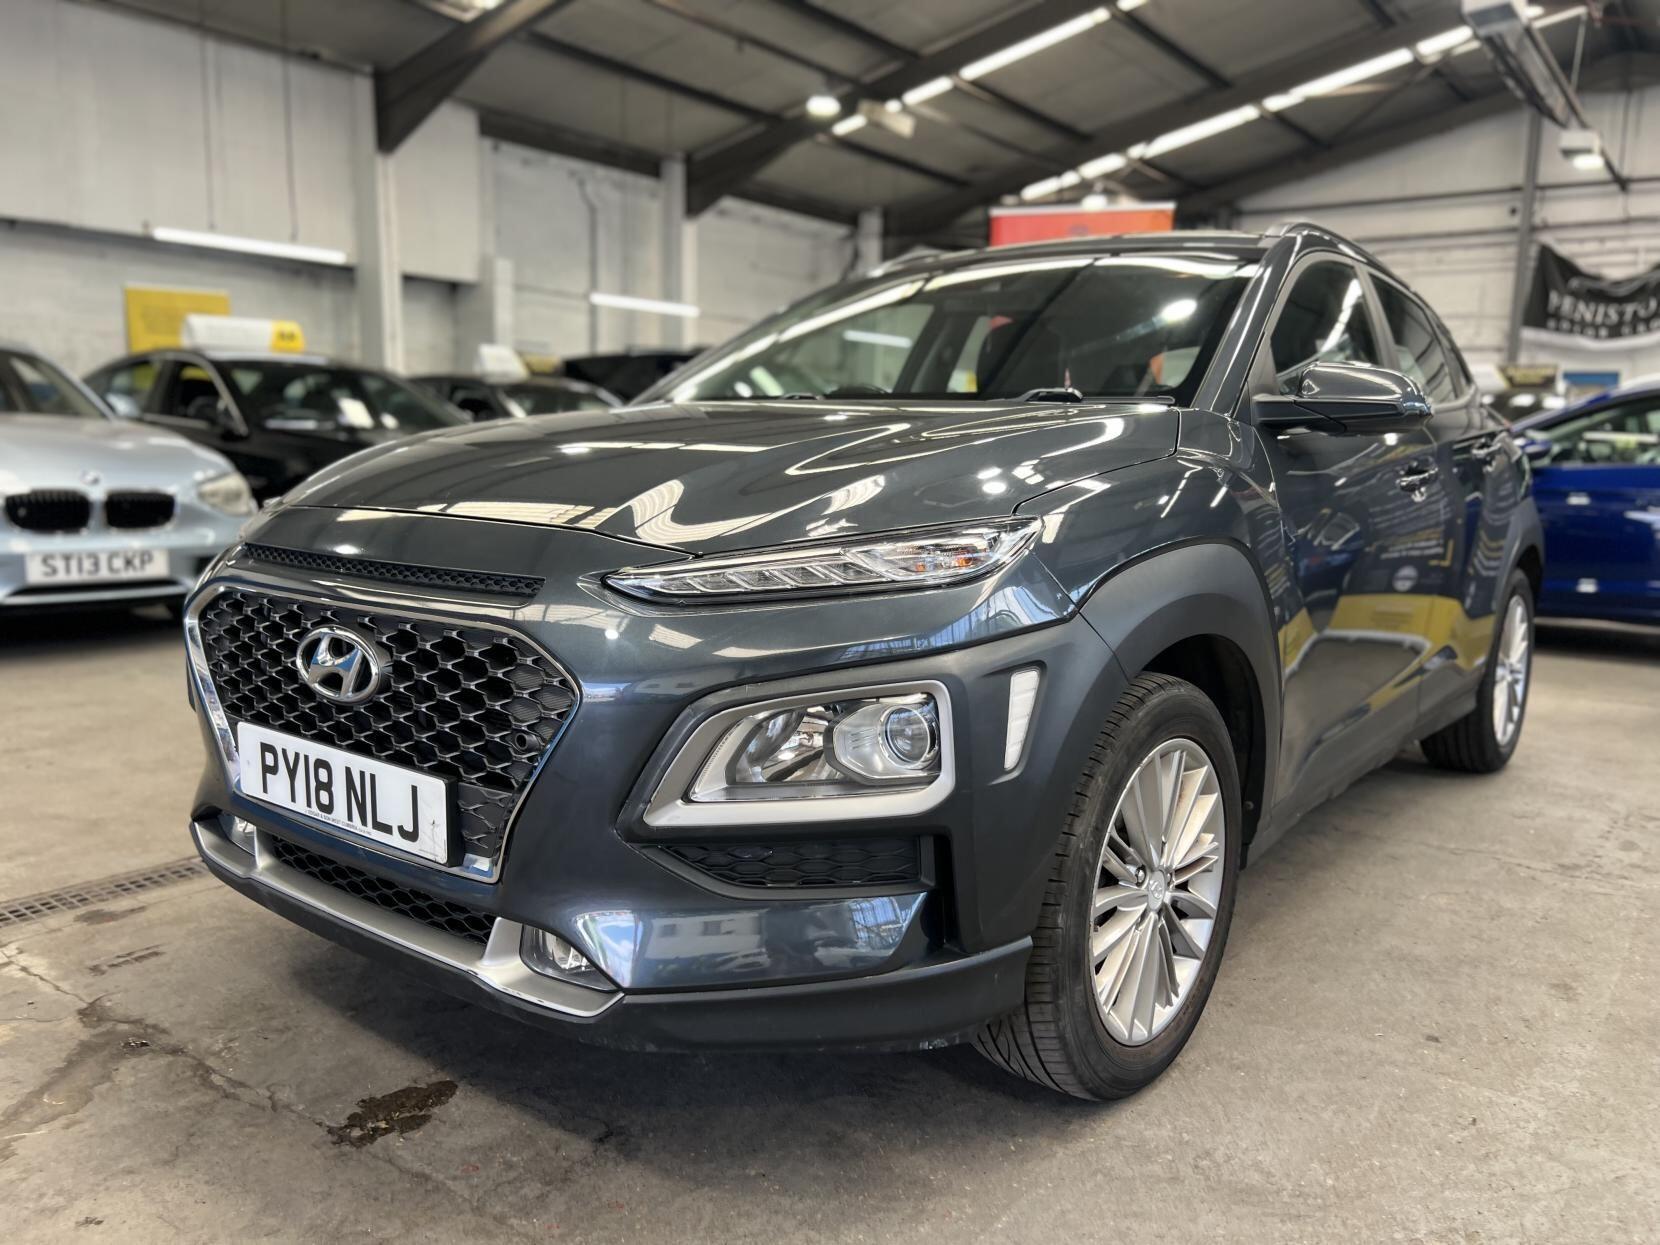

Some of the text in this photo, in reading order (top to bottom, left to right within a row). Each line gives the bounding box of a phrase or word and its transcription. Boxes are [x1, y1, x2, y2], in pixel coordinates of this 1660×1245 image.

[41, 550, 154, 577] ST13 CKP
[260, 741, 420, 842] PY18 NLJ
